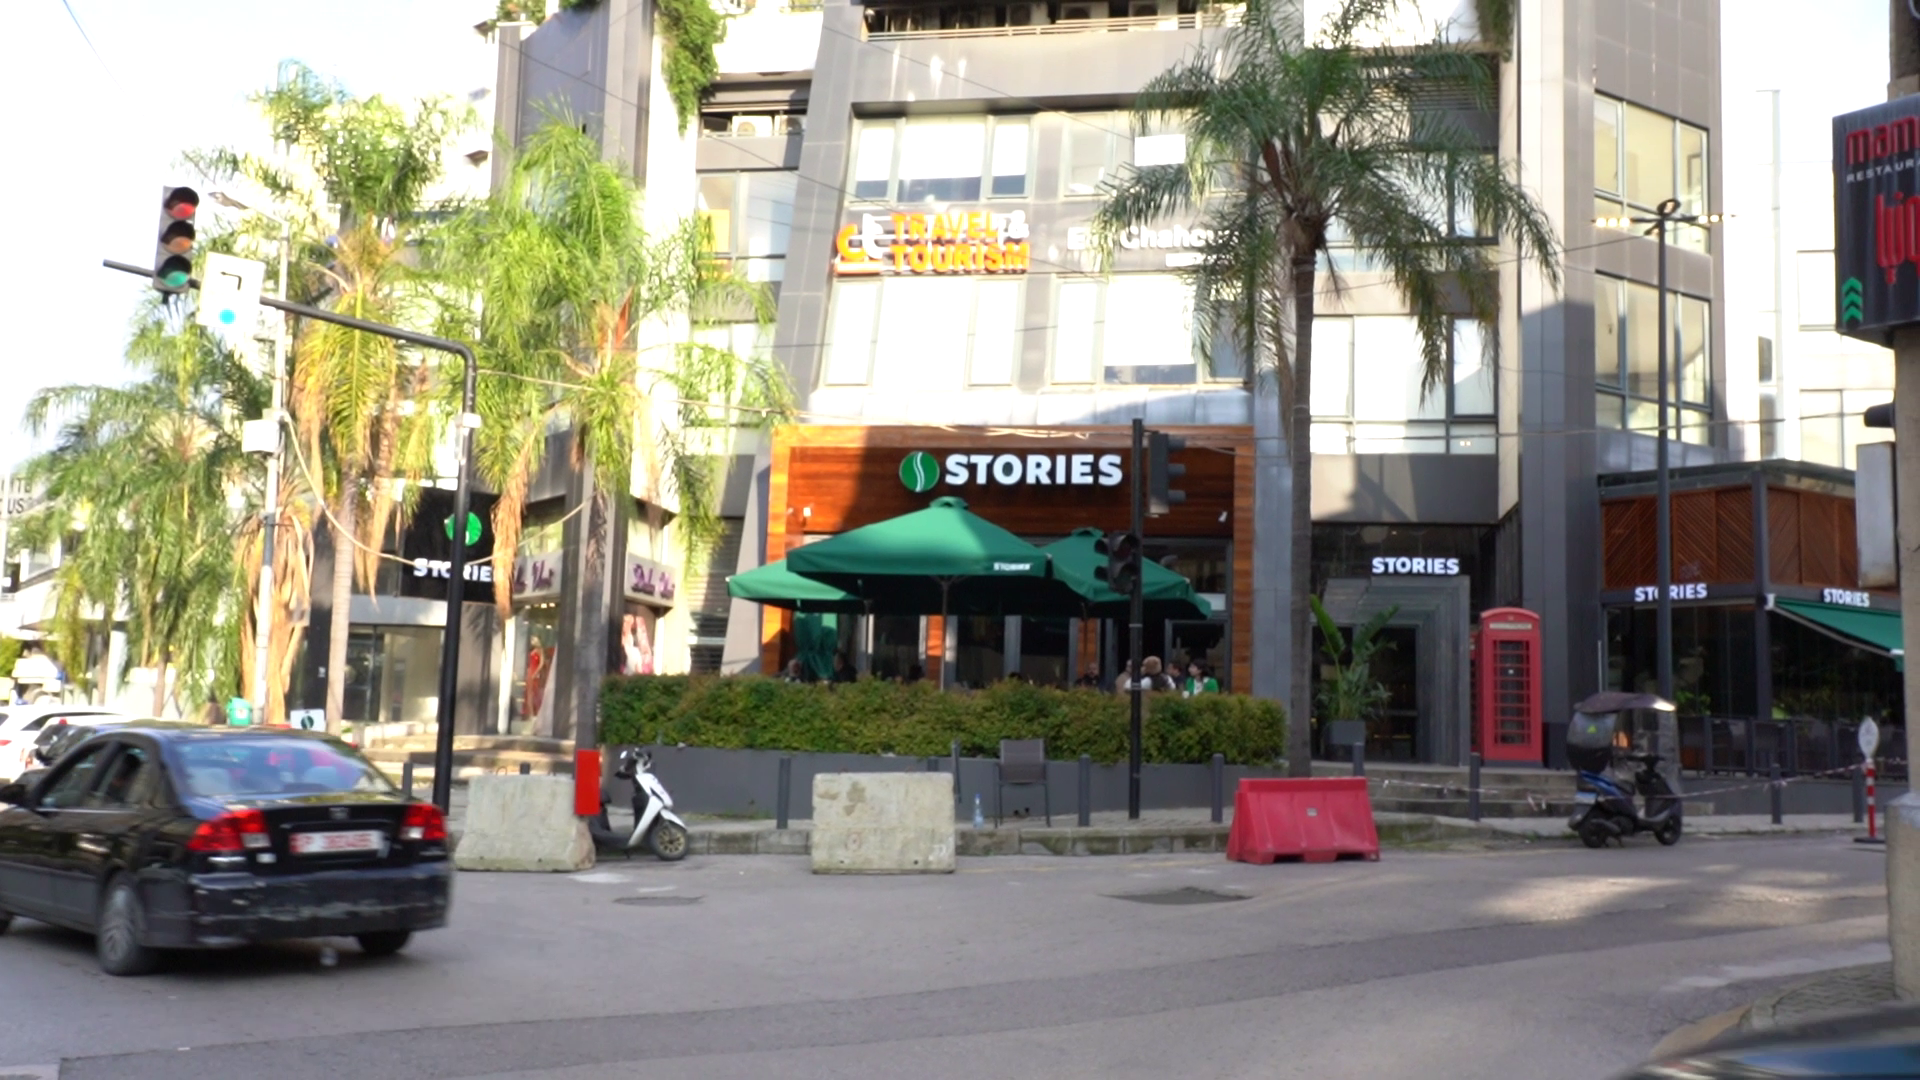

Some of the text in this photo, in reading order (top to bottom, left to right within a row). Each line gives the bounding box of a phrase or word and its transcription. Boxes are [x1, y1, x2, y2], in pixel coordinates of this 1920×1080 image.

[890, 211, 999, 241] TRAVEL
[890, 243, 1030, 273] TOURISM
[944, 453, 1123, 486] STORIES
[413, 557, 493, 582] STORIE
[1372, 556, 1460, 575] STORIES
[1823, 588, 1870, 608] STORIES
